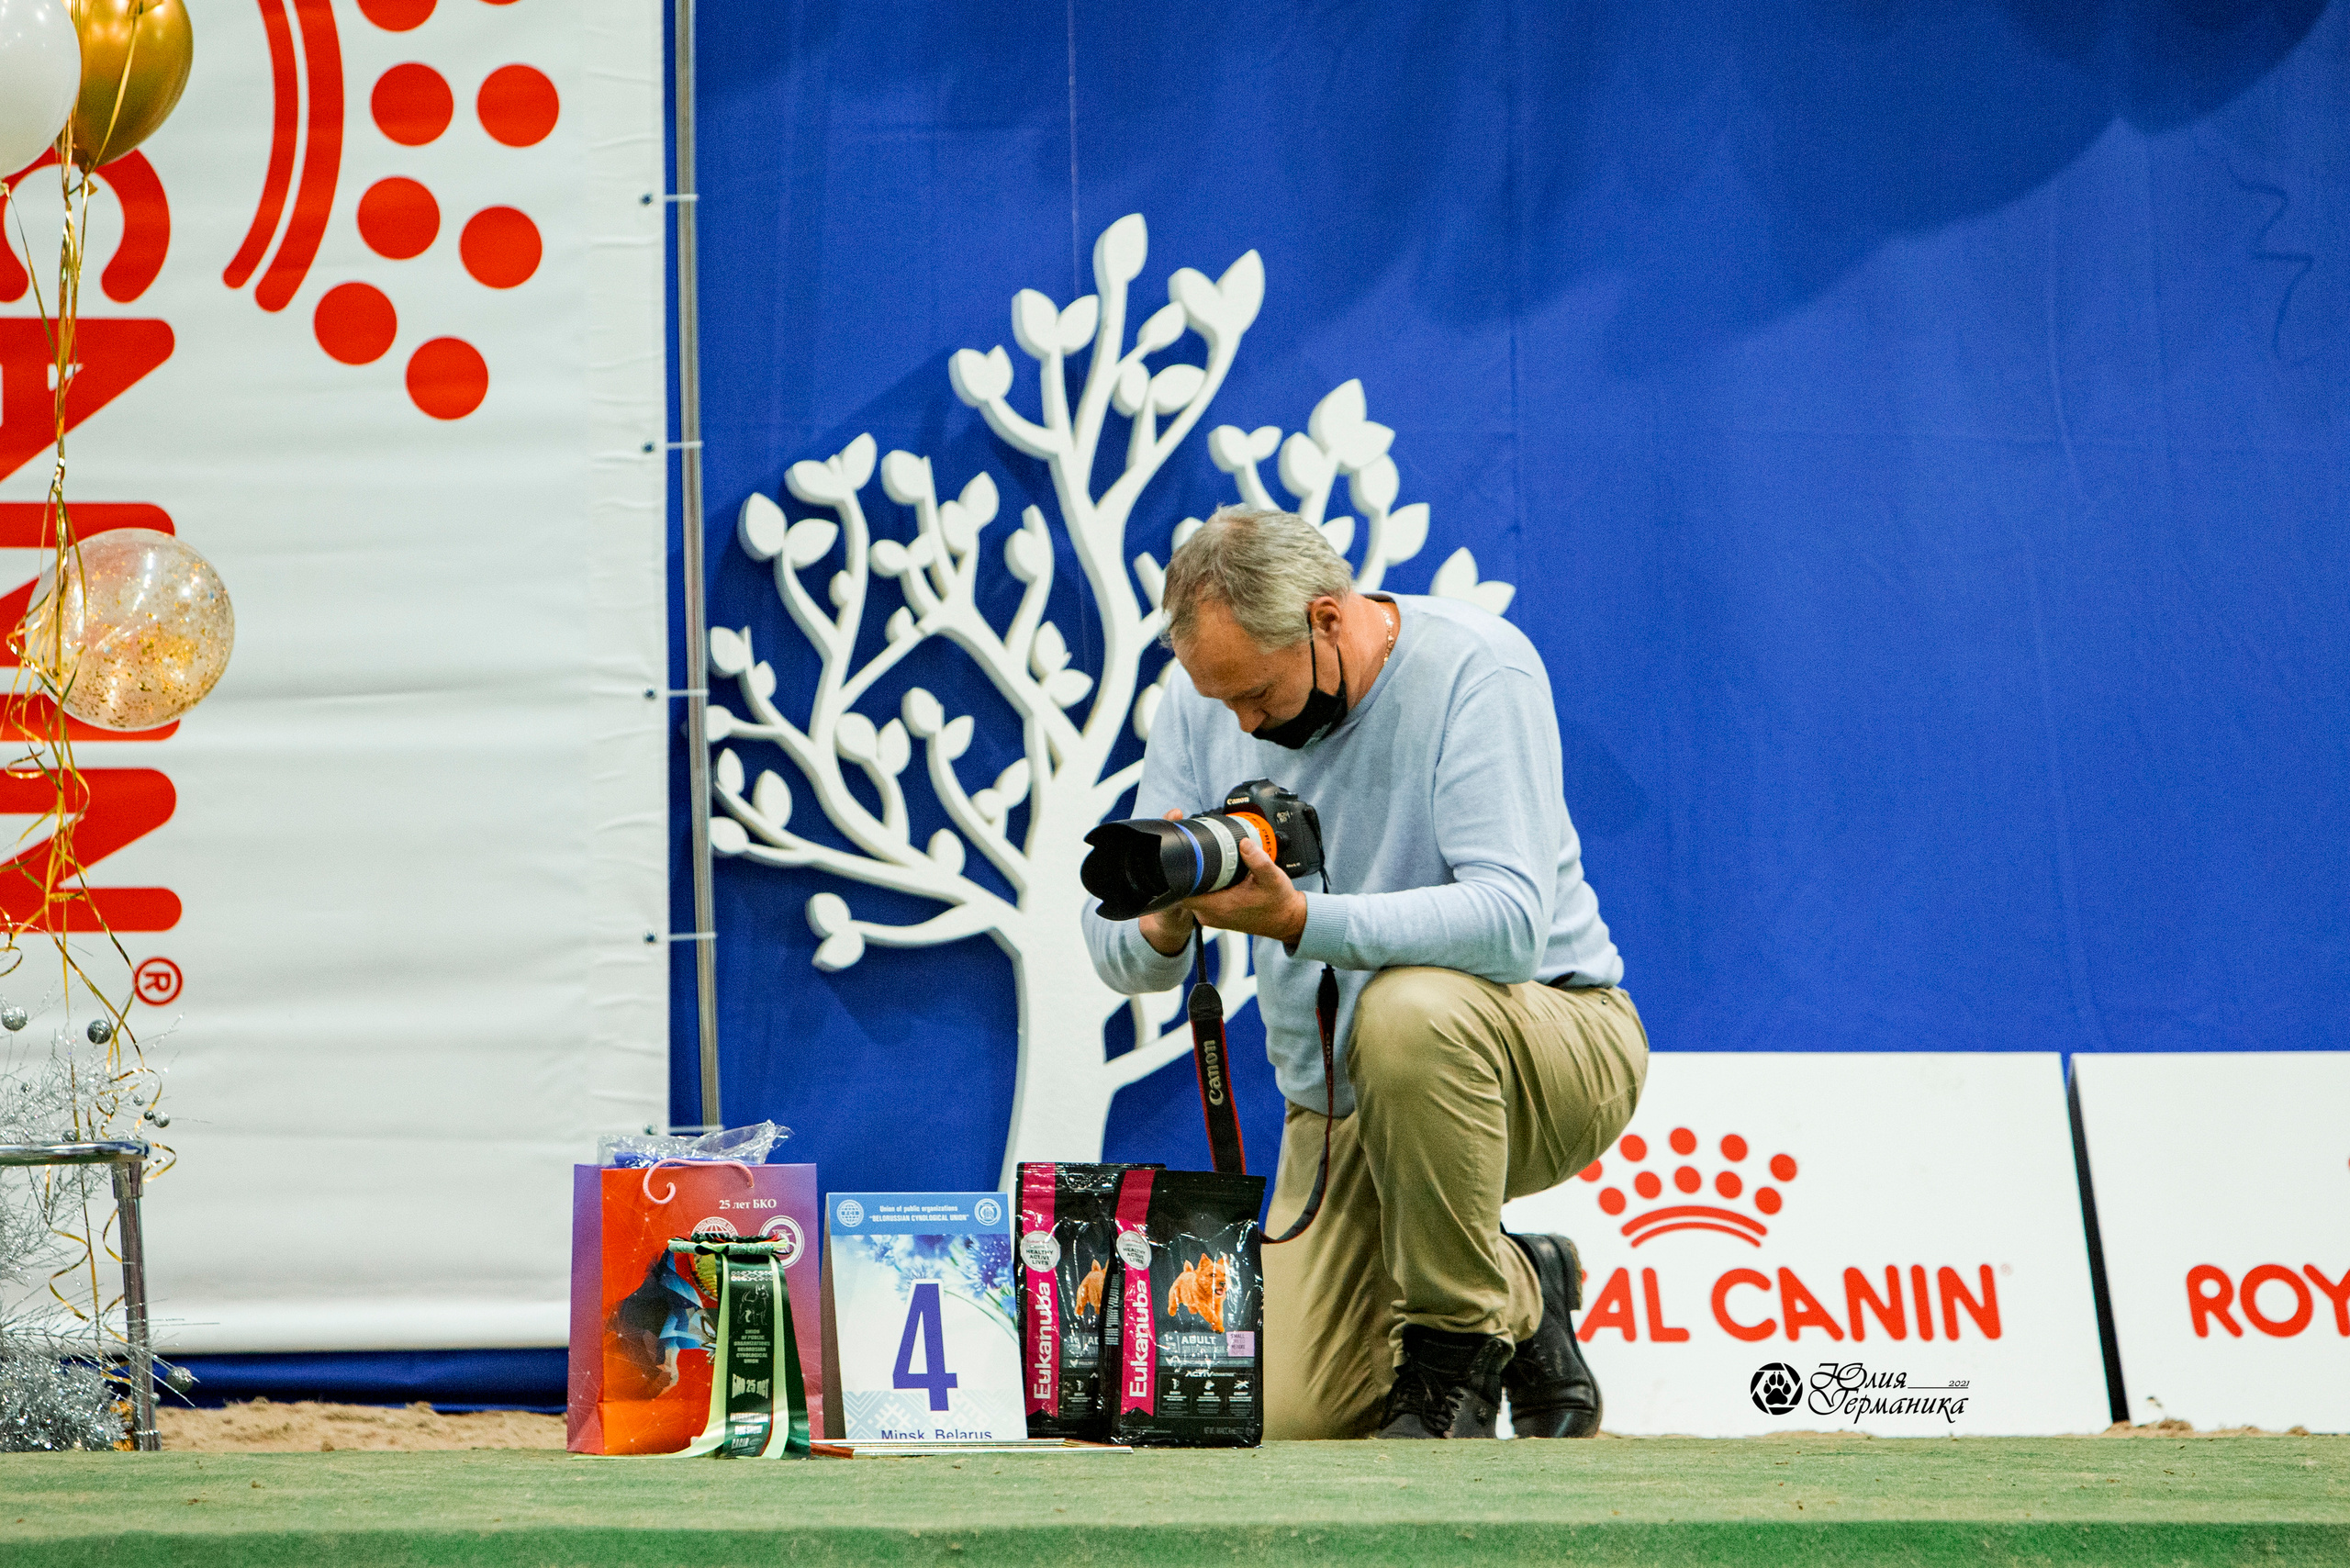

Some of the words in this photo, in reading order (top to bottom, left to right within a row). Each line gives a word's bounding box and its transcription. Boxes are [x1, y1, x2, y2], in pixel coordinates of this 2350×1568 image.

[1226, 796, 1249, 806] Canon
[1203, 1039, 1224, 1106] Canon
[719, 1199, 731, 1209] 25
[733, 1201, 750, 1209] лет
[753, 1198, 778, 1209] БКО
[879, 1204, 896, 1213] Union
[896, 1204, 902, 1213] of
[903, 1204, 920, 1214] public
[921, 1204, 958, 1213] organizations
[911, 1214, 948, 1222] CYNOLOGICAL
[1710, 1263, 2002, 1342] CANIN
[1034, 1282, 1051, 1399] Eukanuba
[1129, 1280, 1149, 1397] Eukanuba
[1181, 1335, 1216, 1345] ADULT
[892, 1282, 958, 1411] 4
[745, 1379, 756, 1394] 25
[934, 1428, 992, 1439] Belarus
